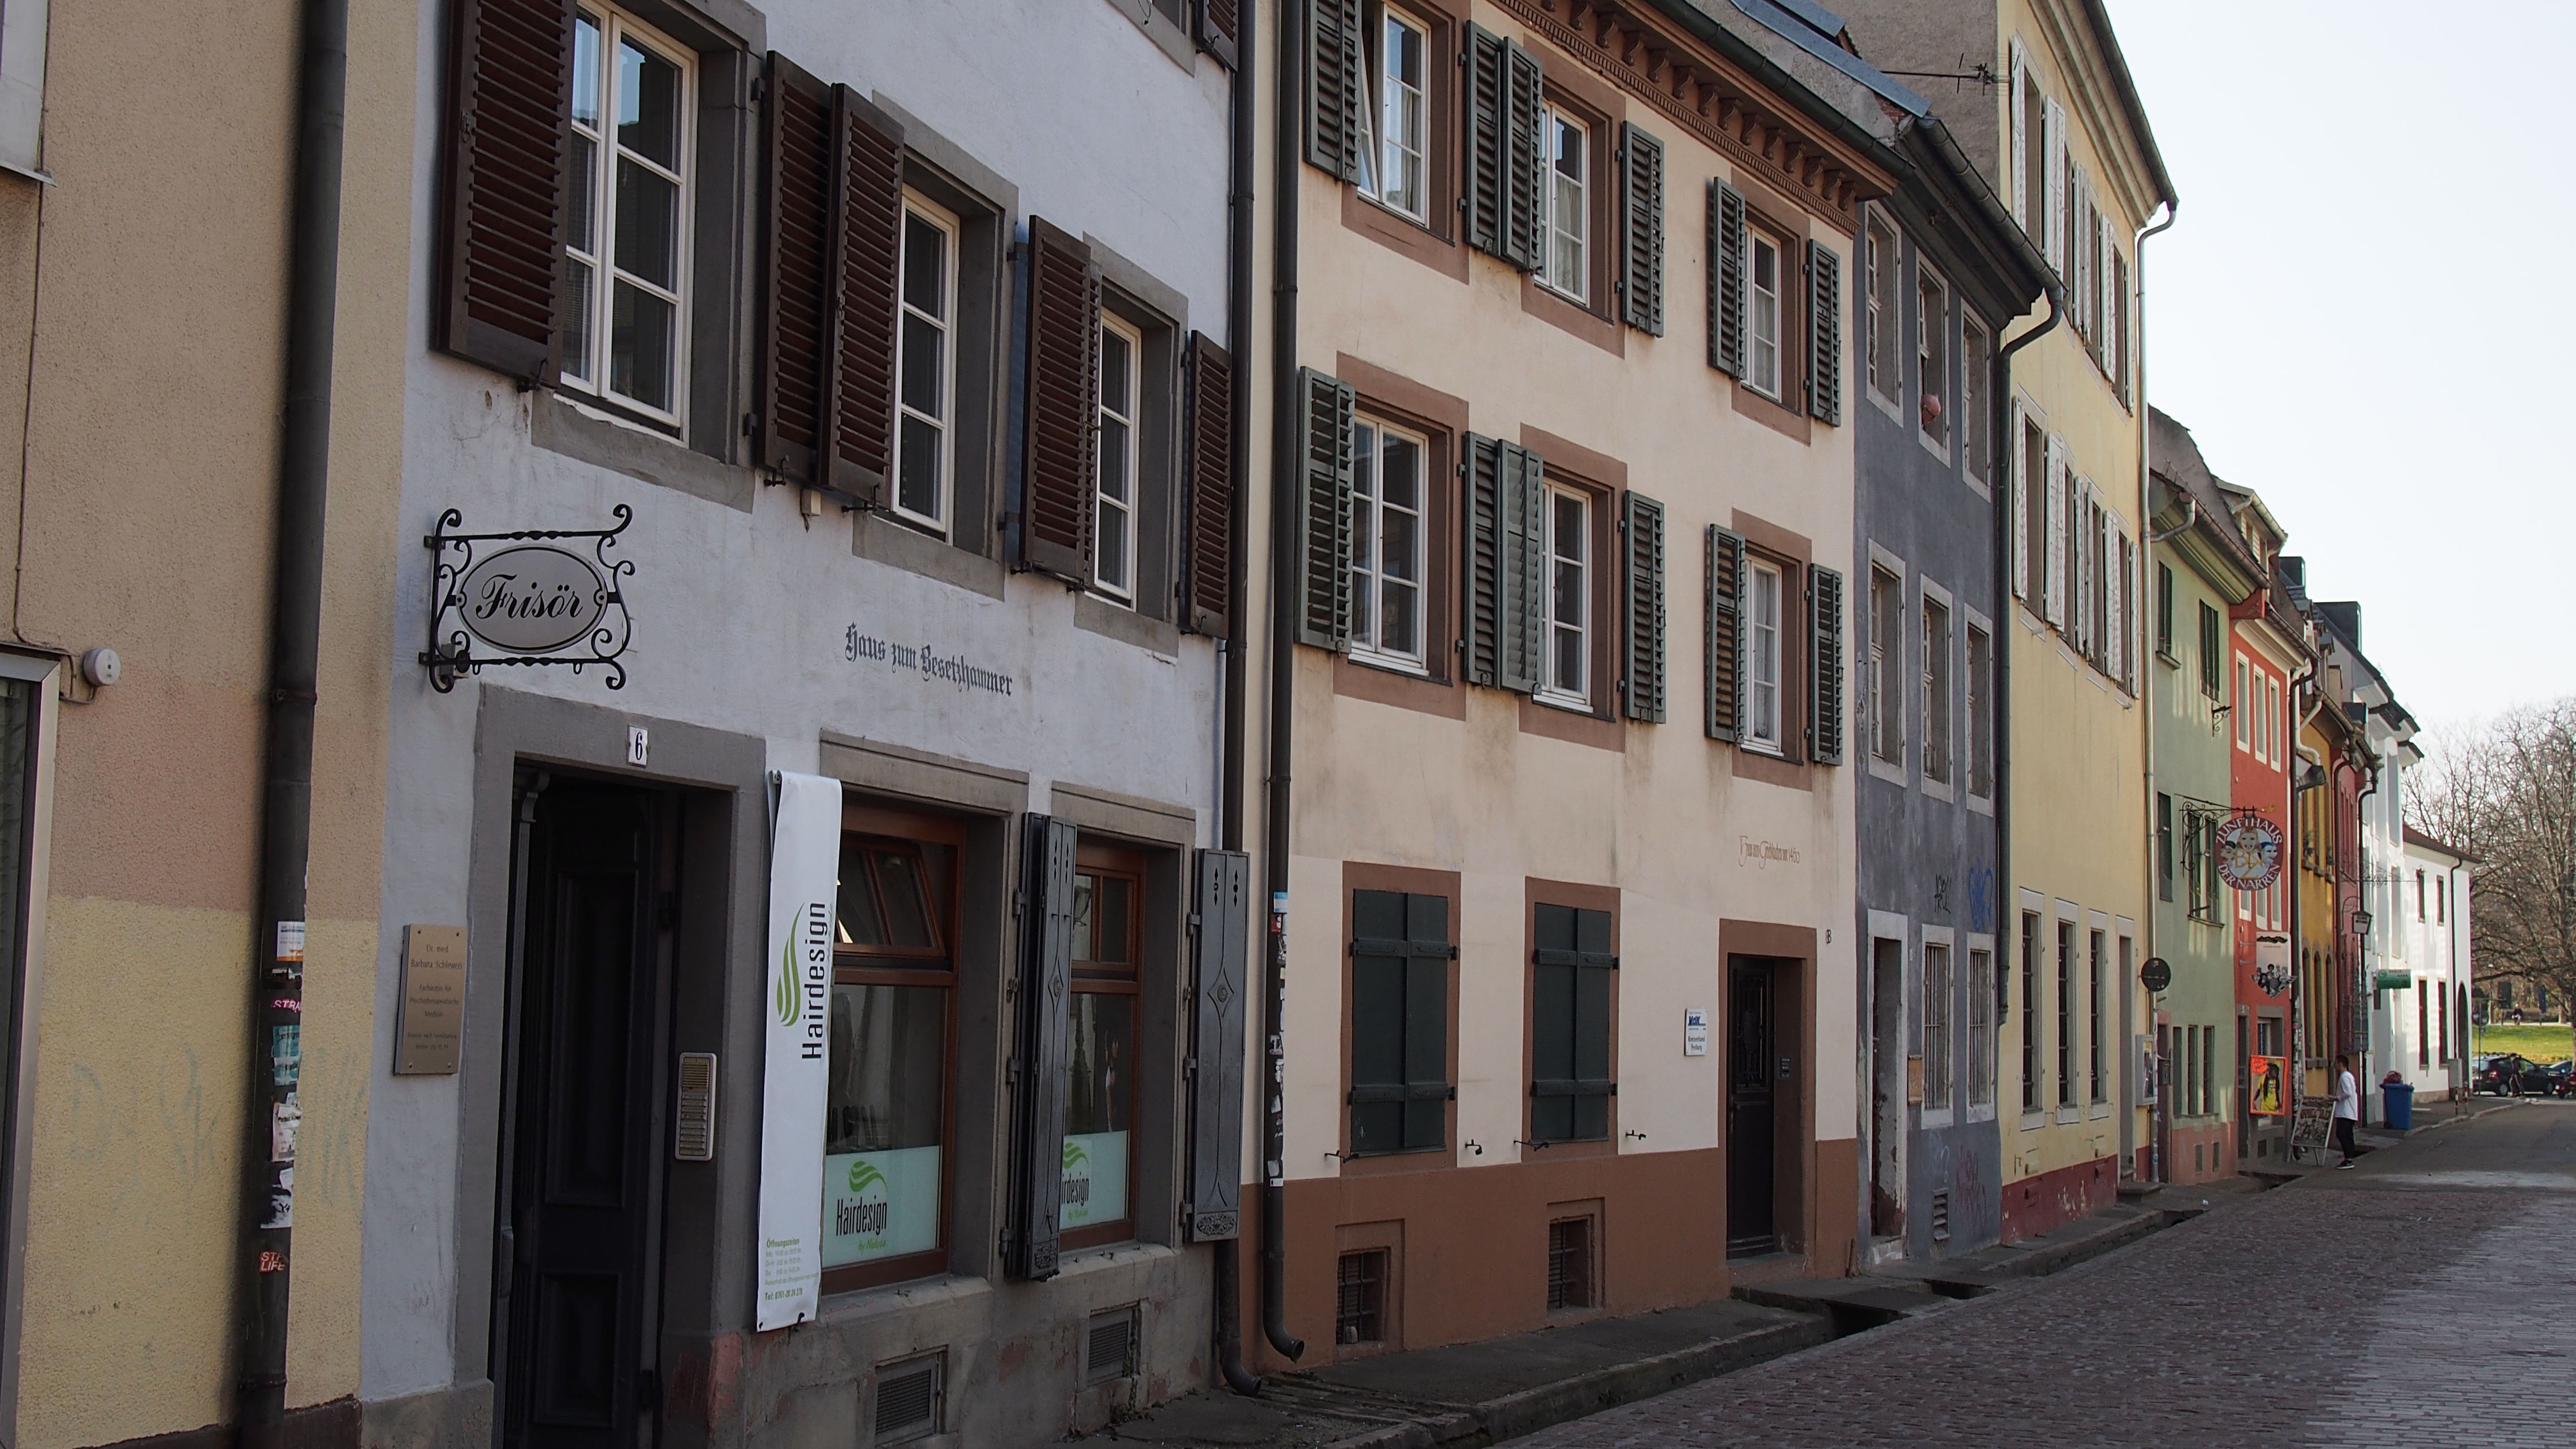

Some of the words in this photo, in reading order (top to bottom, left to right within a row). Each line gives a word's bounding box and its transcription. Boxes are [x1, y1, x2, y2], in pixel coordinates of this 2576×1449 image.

[476, 574, 584, 620] Frisör
[845, 621, 887, 663] Haus
[891, 642, 917, 673] zum
[635, 732, 643, 760] 6
[2216, 818, 2283, 845] ZUNFTHAUS
[2218, 864, 2236, 885] DER
[2236, 863, 2280, 889] NARREN
[411, 959, 433, 968] Barbara
[802, 903, 828, 1059] Hairdesign
[1061, 1171, 1090, 1206] irdesign
[836, 1195, 888, 1236] Hairdesign
